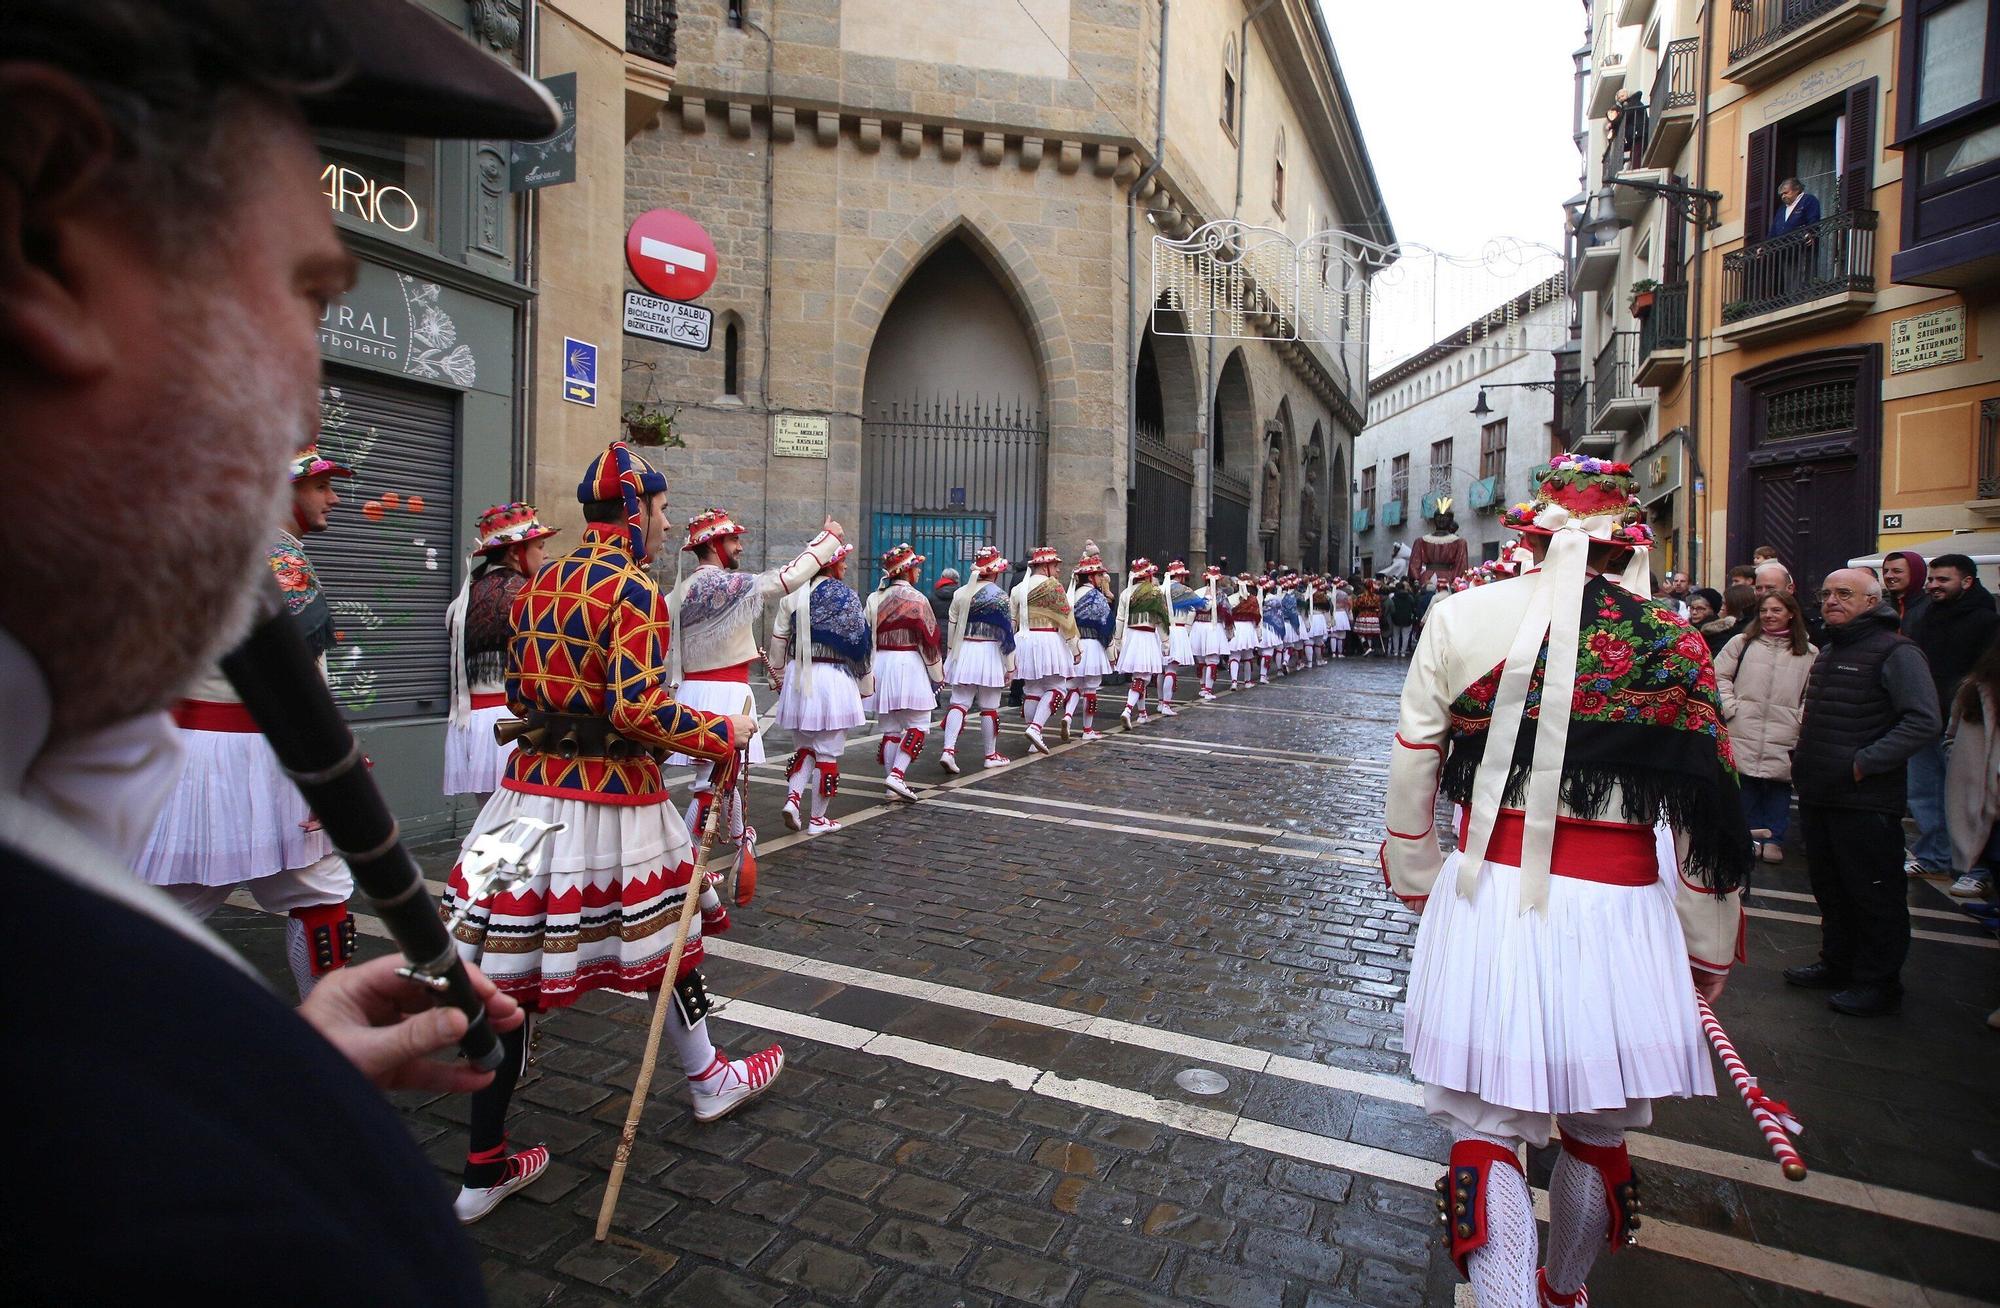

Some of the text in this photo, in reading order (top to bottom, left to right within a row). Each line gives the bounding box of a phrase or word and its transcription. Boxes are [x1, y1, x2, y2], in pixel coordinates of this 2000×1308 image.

[628, 307, 671, 324] BICICLETAS
[630, 295, 669, 312] EXCEPTO
[678, 306, 707, 321] SALBU:
[627, 319, 669, 335] BIZIKLETAK
[1917, 318, 1940, 329] CALLE
[1897, 323, 1957, 344] SAN SATURNINO
[316, 333, 397, 361] rbolario
[1895, 336, 1959, 357] SAN SATURNINO
[1913, 350, 1938, 362] KALEA
[1885, 516, 1900, 527] 14
